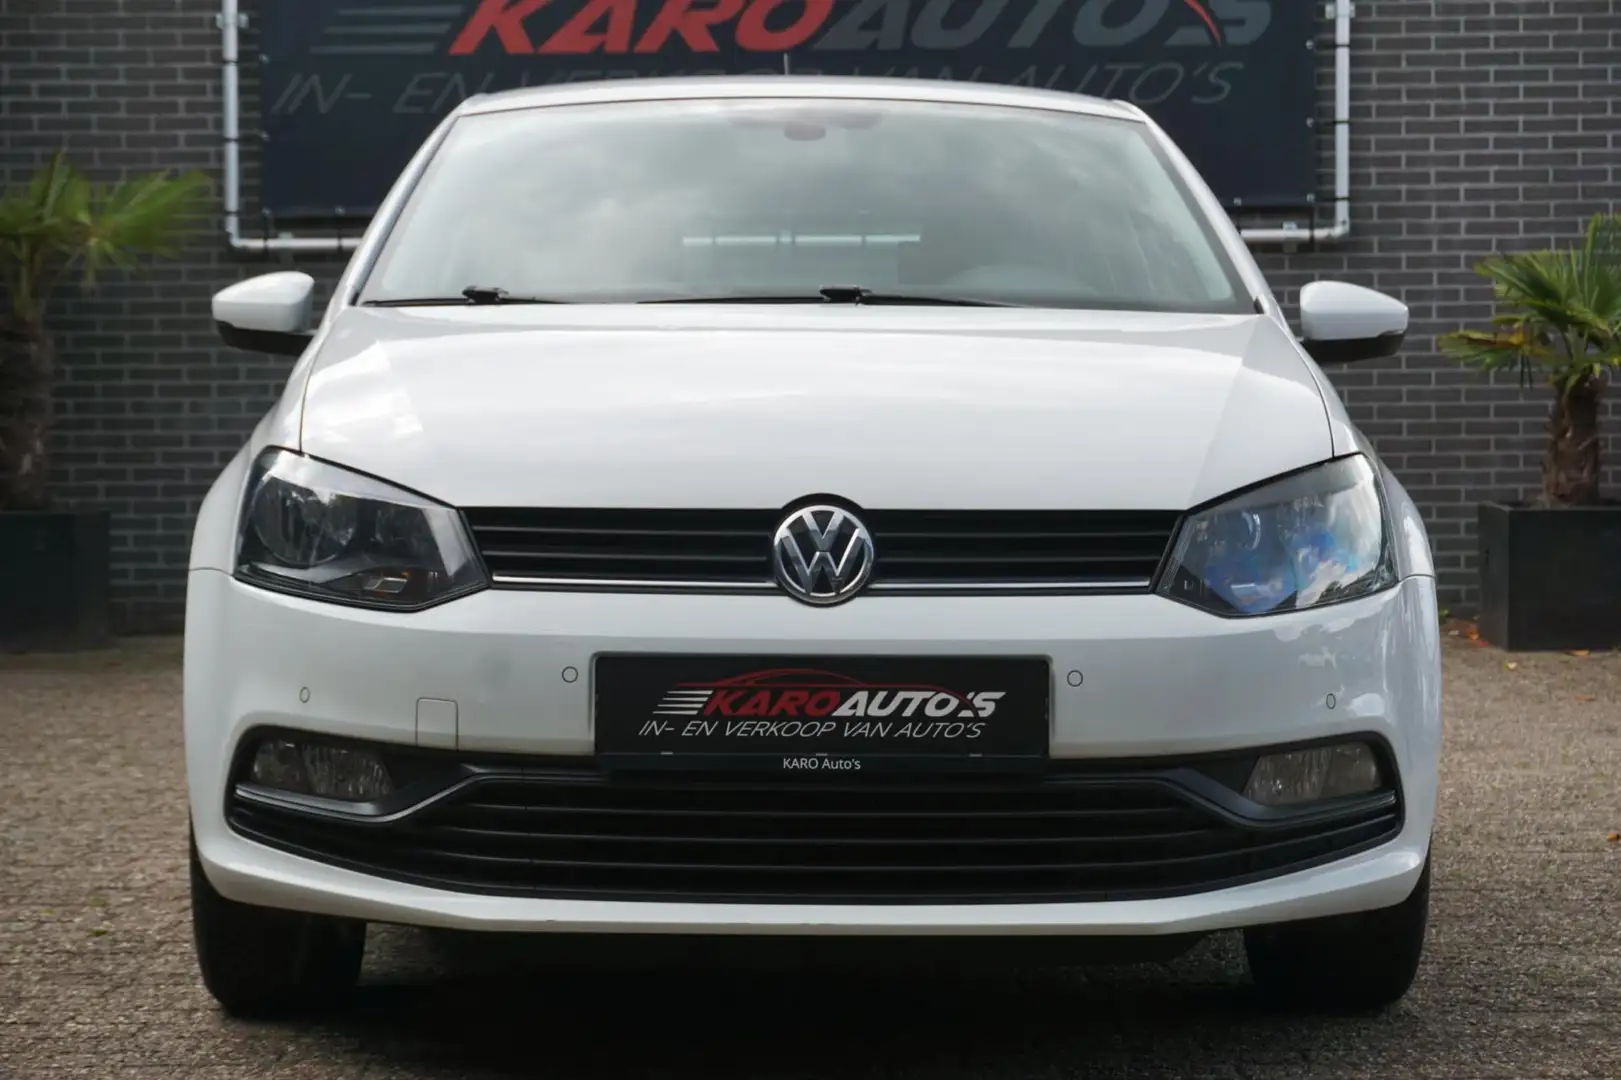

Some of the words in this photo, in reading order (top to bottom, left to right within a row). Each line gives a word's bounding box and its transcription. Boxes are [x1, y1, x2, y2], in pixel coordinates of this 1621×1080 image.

[271, 72, 373, 114] IN-
[638, 720, 675, 737] IN-
[681, 720, 720, 737] EN
[724, 721, 837, 738] VERKOOP
[842, 722, 900, 739] VAN
[893, 722, 987, 739] AUTO'S
[783, 758, 819, 770] KARO
[821, 758, 862, 771] Auto's
